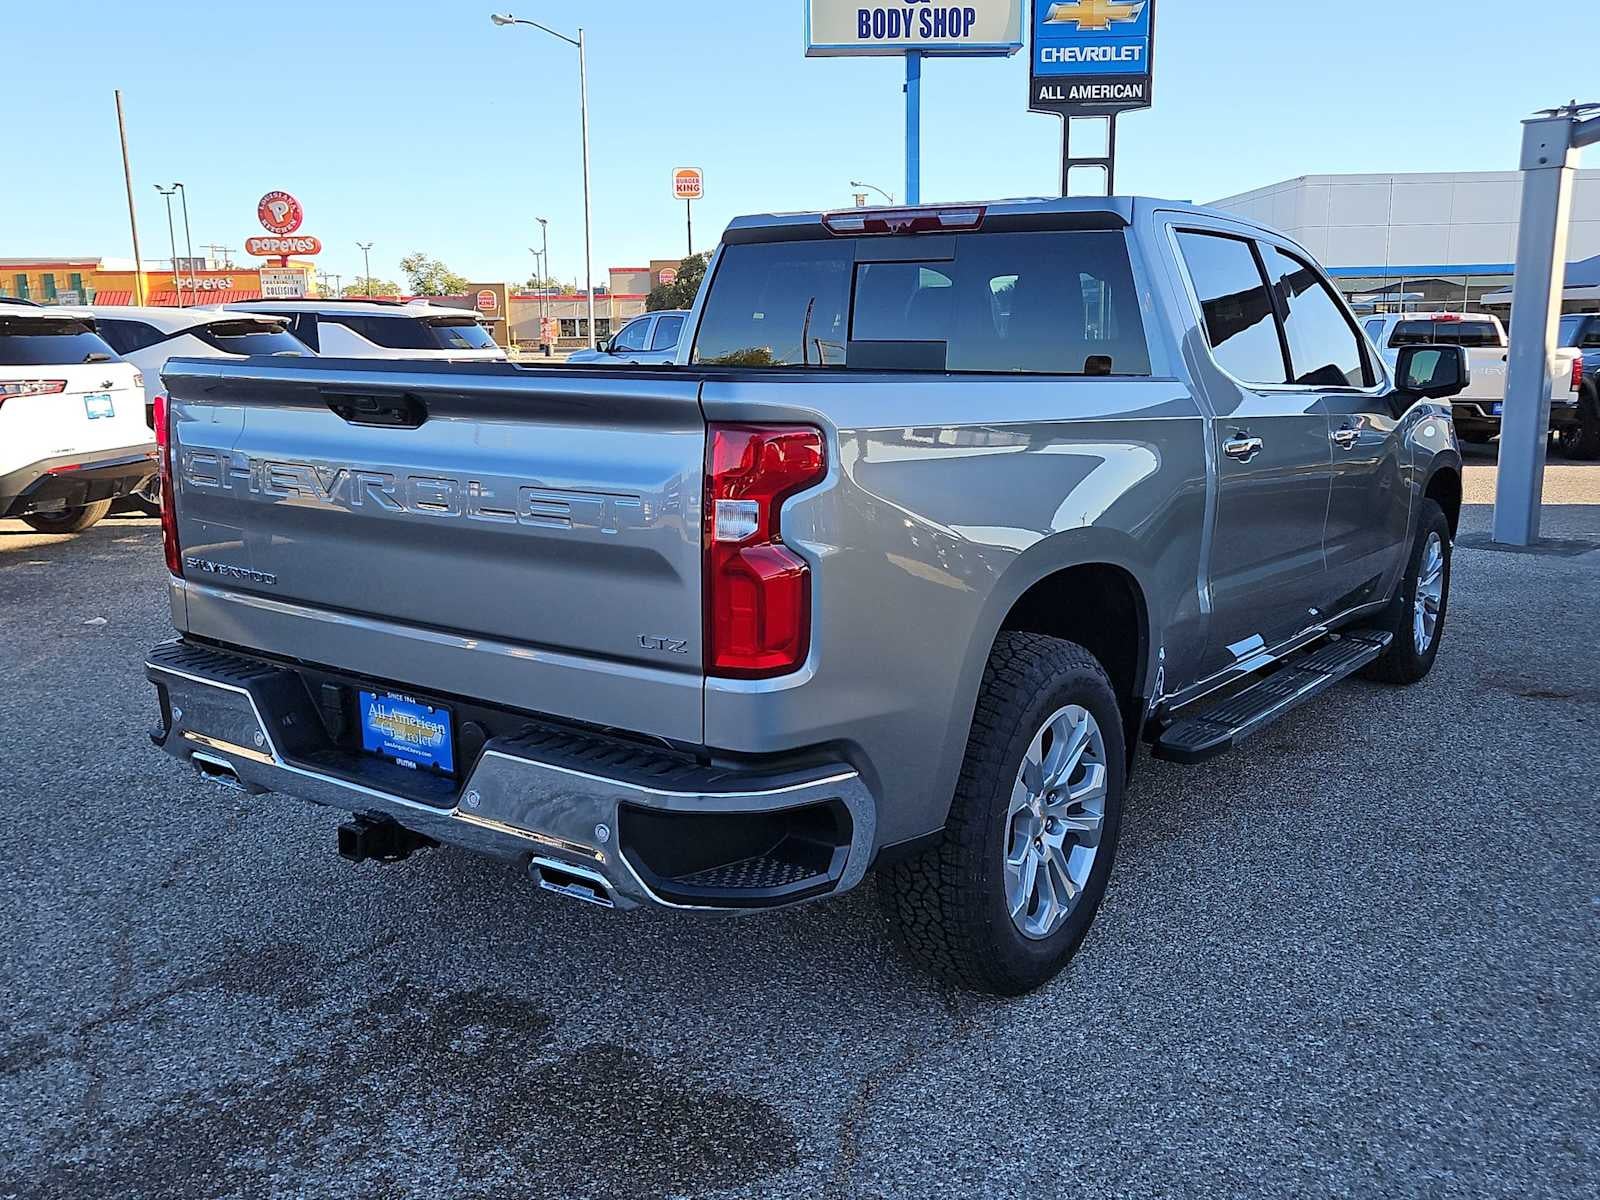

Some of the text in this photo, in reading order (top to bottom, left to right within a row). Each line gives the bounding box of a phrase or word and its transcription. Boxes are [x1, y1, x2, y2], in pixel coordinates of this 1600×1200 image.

[857, 7, 976, 39] BODY SHOP
[1041, 46, 1143, 62] CHEVROLET
[1039, 84, 1143, 100] ALL AMERICAN
[676, 184, 700, 192] KING
[266, 286, 299, 296] COLLISION
[184, 449, 642, 534] CHEVROLET
[637, 635, 688, 653] LTZ
[369, 704, 446, 734] All American
